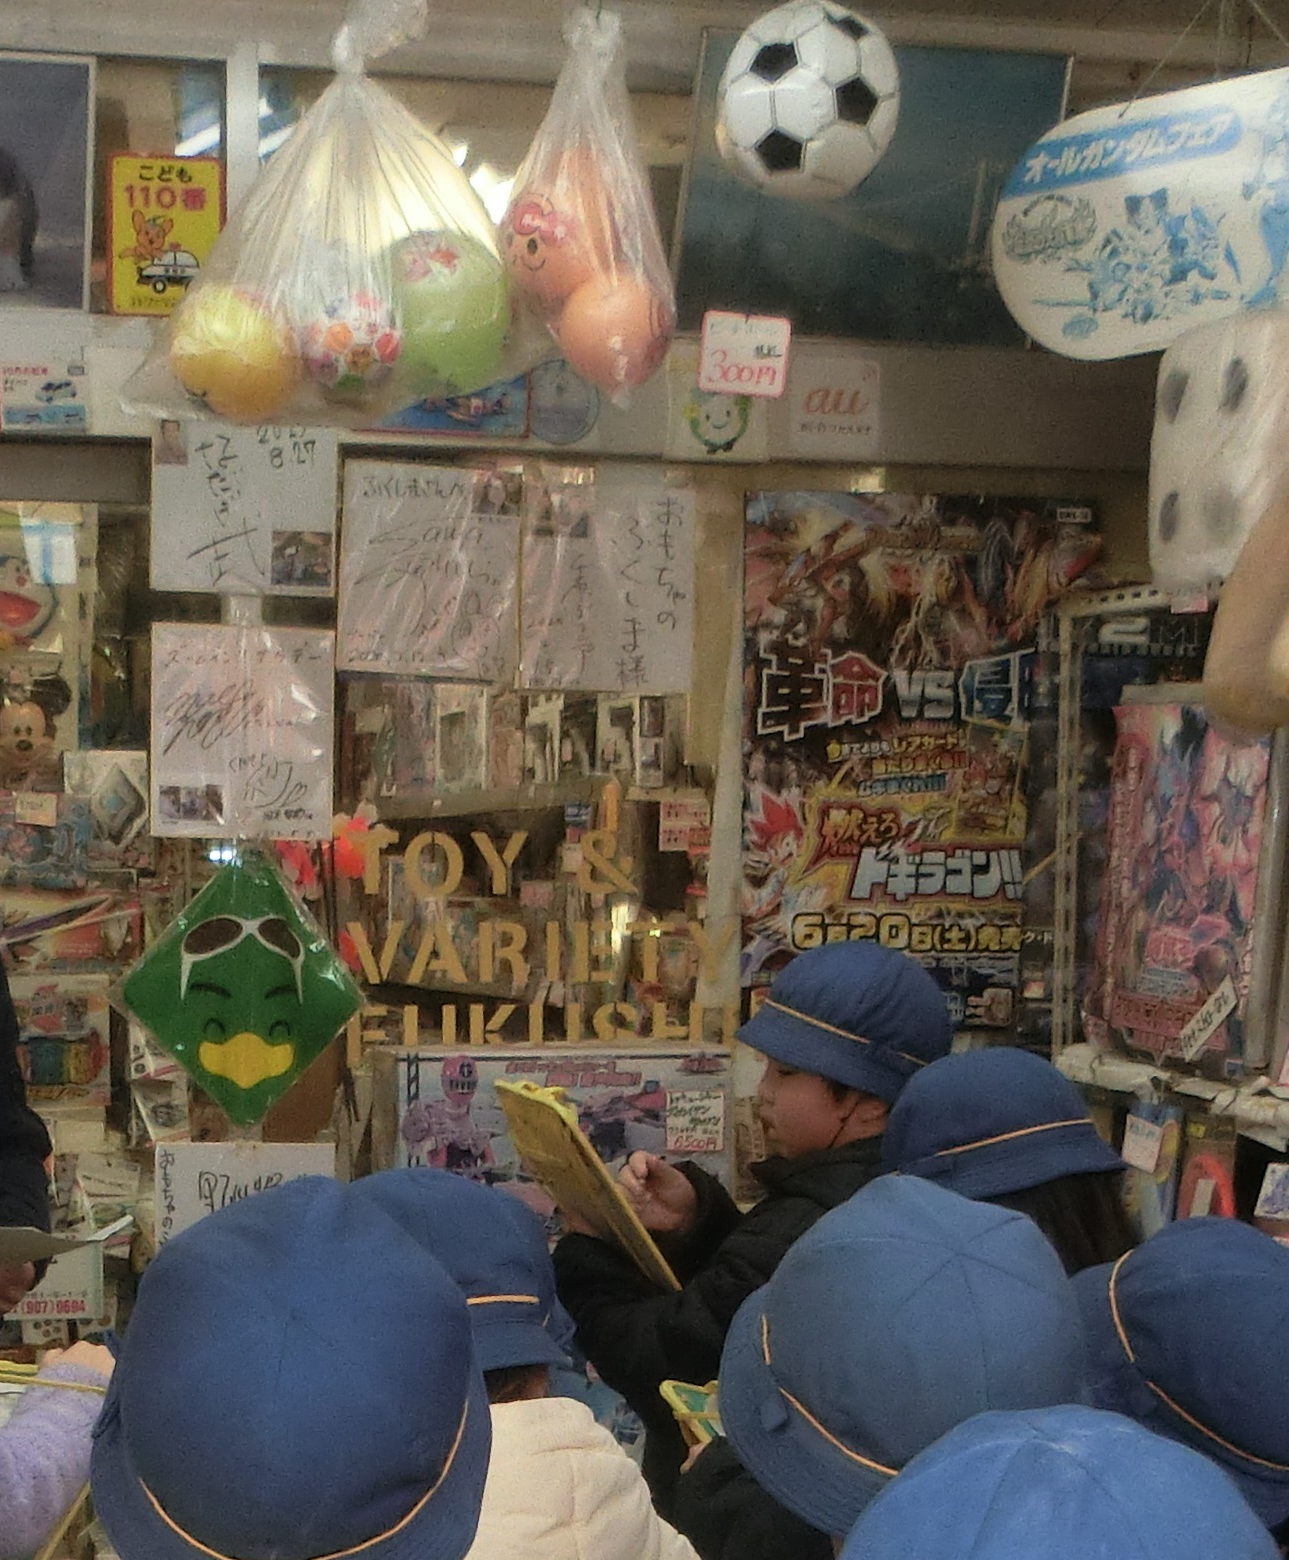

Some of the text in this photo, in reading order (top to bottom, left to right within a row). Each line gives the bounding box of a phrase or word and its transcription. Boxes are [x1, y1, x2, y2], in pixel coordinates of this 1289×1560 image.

[139, 164, 193, 184] こども
[708, 350, 778, 386] 300円
[803, 388, 869, 416] au
[270, 447, 284, 469] 8
[656, 497, 687, 630] おもちゃの
[894, 668, 956, 719] VS
[351, 829, 640, 899] TOY &
[345, 920, 740, 986] VARIETY
